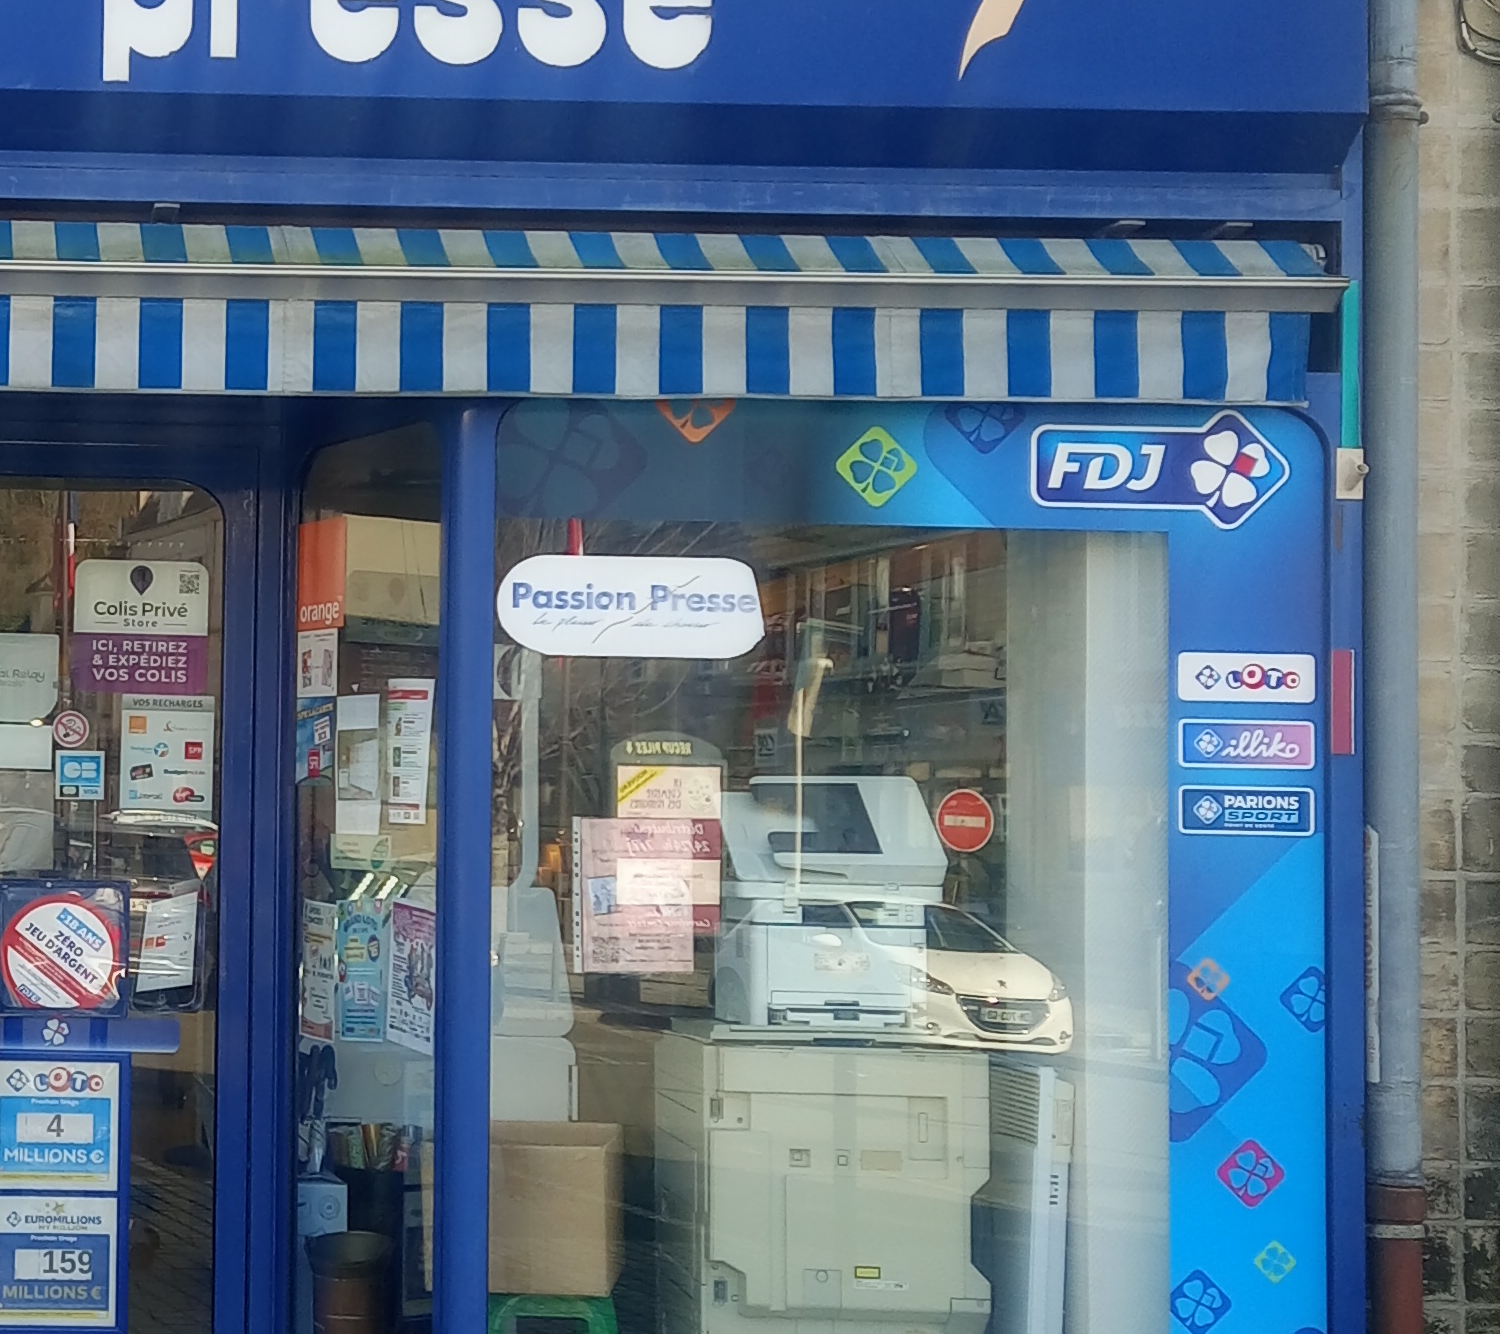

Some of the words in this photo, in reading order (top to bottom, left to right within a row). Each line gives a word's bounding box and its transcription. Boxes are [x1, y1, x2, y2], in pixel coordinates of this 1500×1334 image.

[1047, 442, 1166, 491] FDJ
[512, 582, 637, 611] Passion
[650, 584, 758, 613] Presse
[93, 600, 138, 617] Colis
[141, 601, 188, 618] Privé
[299, 601, 340, 625] orange
[123, 618, 159, 628] Store
[92, 639, 118, 654] ICI,
[122, 640, 188, 654] RETIREZ
[92, 654, 103, 666] &
[108, 652, 188, 668] EXPÉDIEZ
[12, 668, 46, 683] Relay
[92, 668, 129, 682] VOS
[134, 669, 187, 683] COLIS
[1225, 663, 1301, 690] LOTO
[132, 698, 151, 708] VOS
[152, 698, 204, 709] RECHARGES
[1220, 728, 1301, 759] illiko
[1223, 795, 1300, 810] PARIONS
[1226, 810, 1298, 822] SPORT
[54, 930, 84, 957] ZÉRO
[79, 923, 103, 950] ANS
[25, 922, 47, 942] JEU
[44, 938, 98, 985] D'ARGENT
[34, 1067, 104, 1092] LOTO
[46, 1114, 65, 1138] 4
[3, 1147, 88, 1164] MILLIONS
[88, 1149, 105, 1164] €
[24, 1214, 103, 1226] EUROMILLIONS
[42, 1250, 92, 1275] 159
[2, 1285, 88, 1300] MILLIONS
[90, 1286, 102, 1300] €
